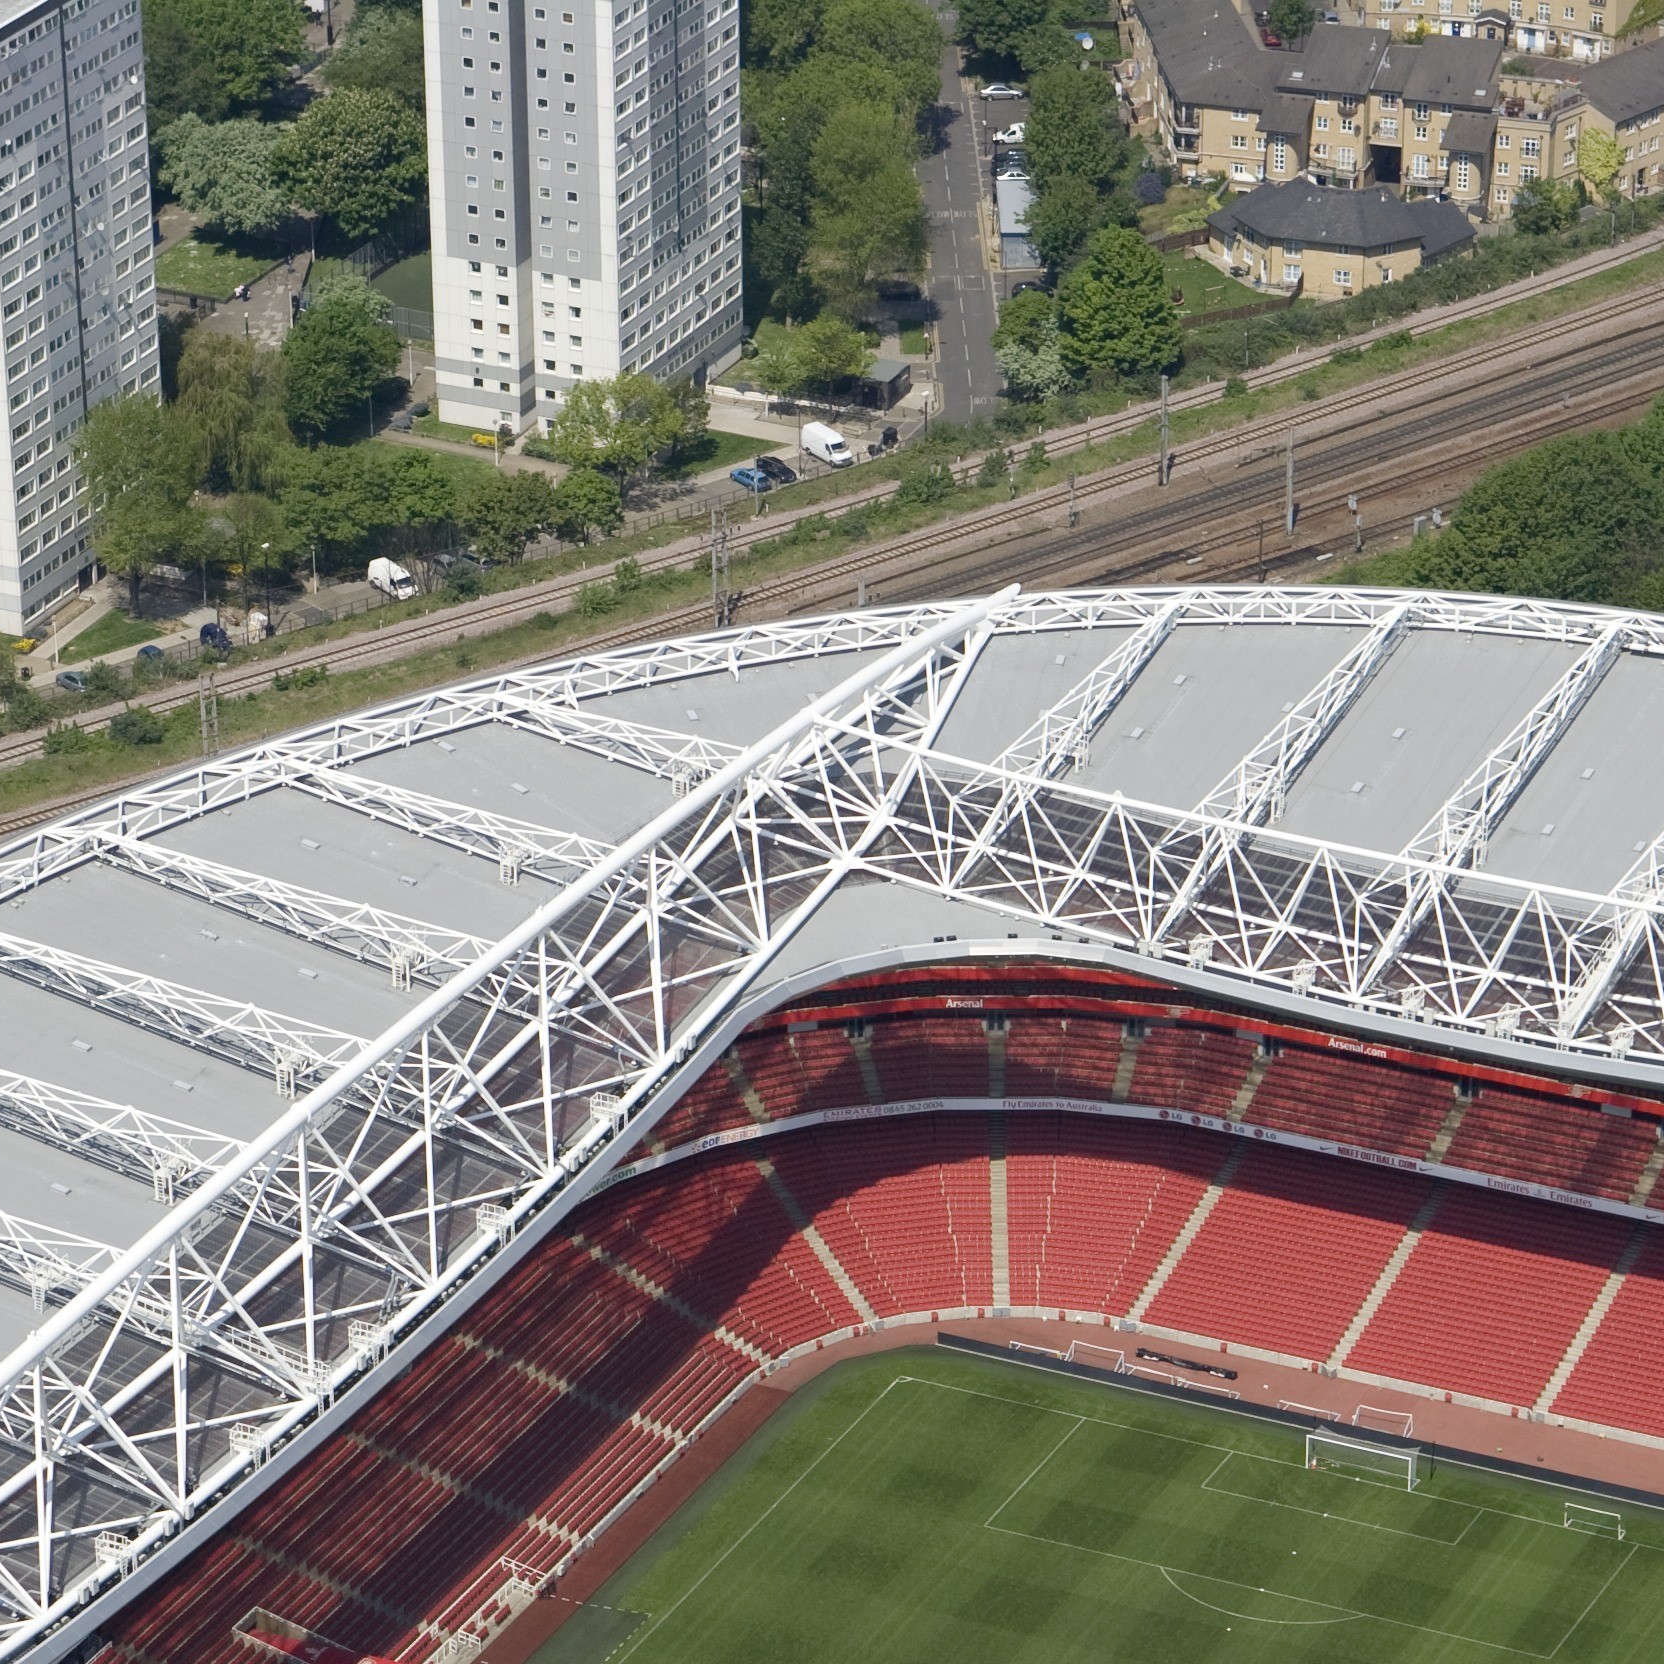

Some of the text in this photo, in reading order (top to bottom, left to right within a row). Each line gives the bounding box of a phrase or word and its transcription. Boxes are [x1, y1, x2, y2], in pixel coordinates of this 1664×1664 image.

[946, 998, 983, 1009] Arsenal
[1328, 1037, 1387, 1058] Arsenal.com
[1067, 1102, 1102, 1112] Australia
[1171, 1112, 1183, 1121] LG
[1202, 1118, 1214, 1127] LG
[1234, 1126, 1245, 1134] LG
[1265, 1132, 1276, 1140] LG
[1487, 1177, 1530, 1194] Emirates
[1549, 1190, 1593, 1207] Emirates
